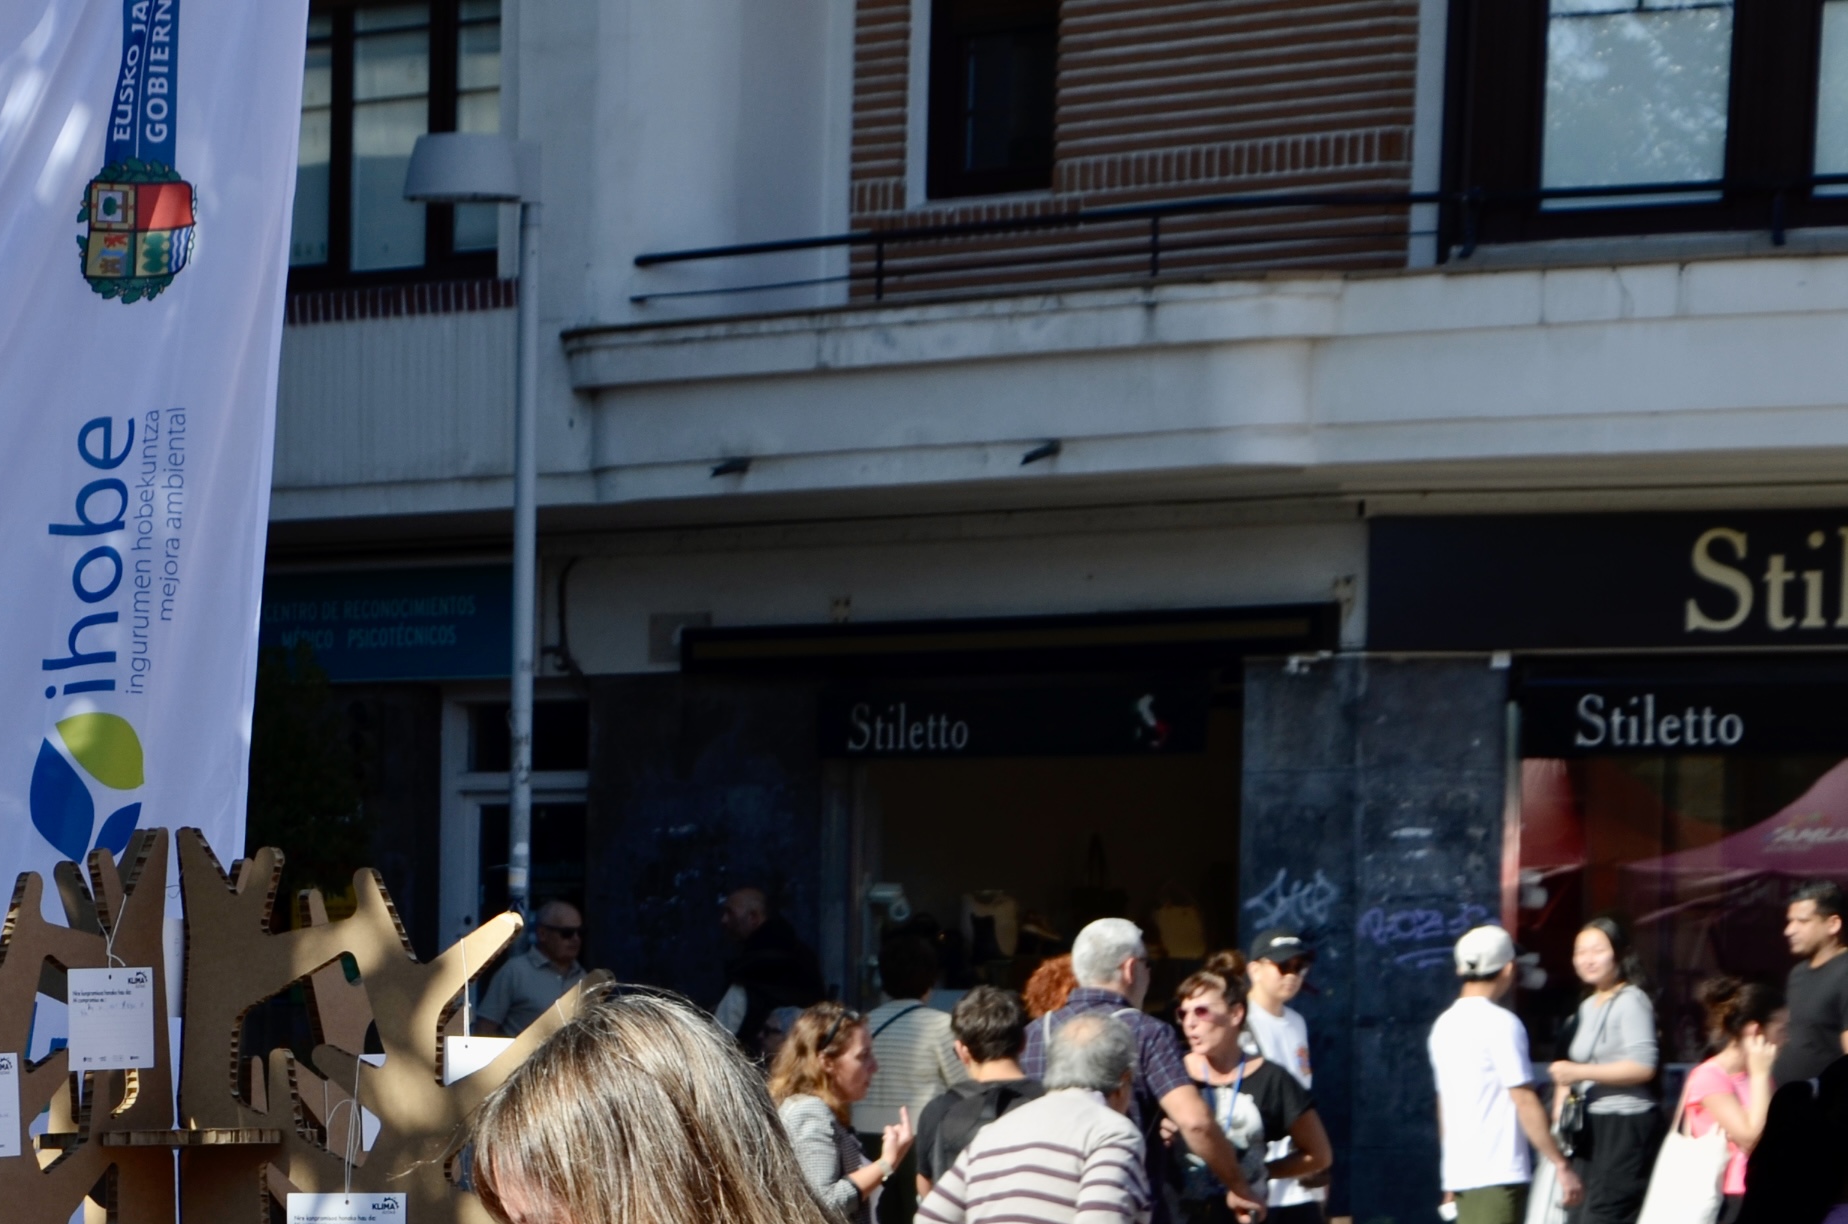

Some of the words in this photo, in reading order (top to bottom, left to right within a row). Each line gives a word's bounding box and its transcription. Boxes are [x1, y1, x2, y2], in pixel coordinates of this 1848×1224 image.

[113, 45, 140, 141] EUSKO
[145, 0, 171, 143] GOBIERN
[130, 409, 159, 551] hobekuntza
[161, 407, 186, 529] ambiental
[42, 416, 135, 699] ihobe
[159, 537, 180, 621] mejora
[126, 557, 152, 694] ingurumen
[847, 701, 969, 751] Stiletto
[1575, 693, 1744, 747] Stiletto
